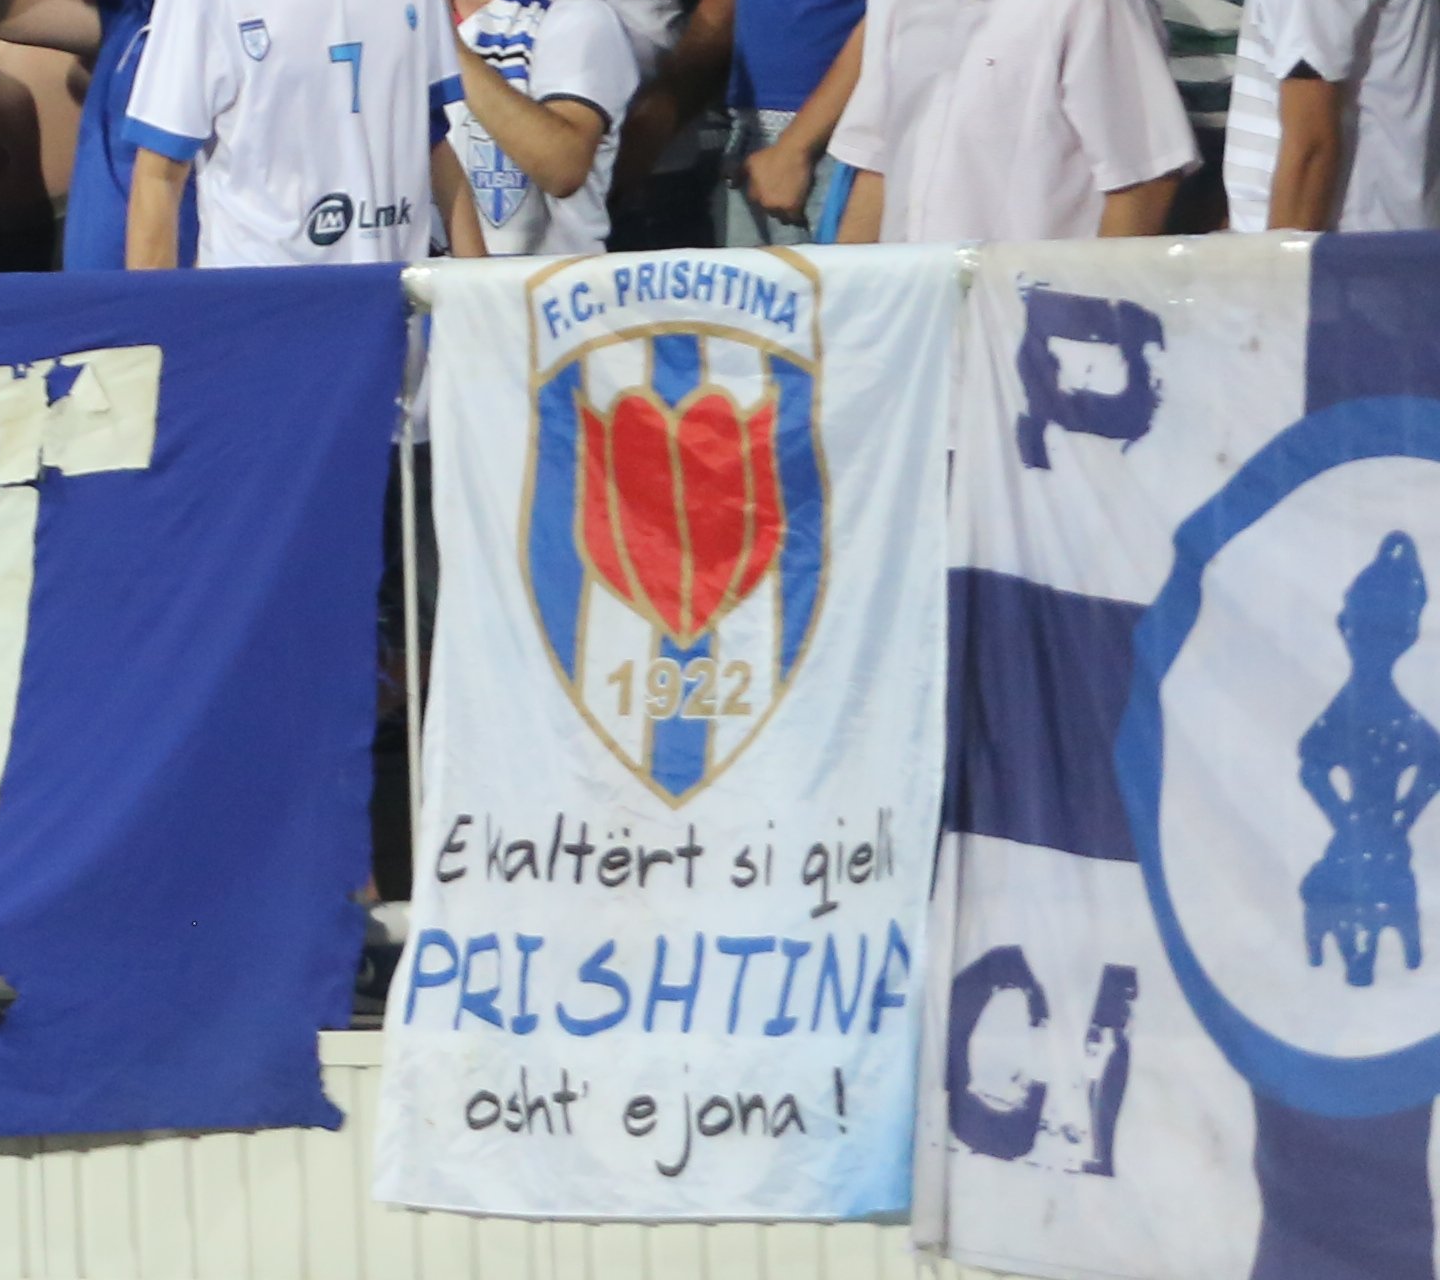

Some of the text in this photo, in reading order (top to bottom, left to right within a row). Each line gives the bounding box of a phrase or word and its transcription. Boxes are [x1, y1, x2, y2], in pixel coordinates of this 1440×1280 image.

[328, 41, 363, 113] 7
[614, 255, 801, 334] PRISHTINA
[604, 656, 755, 722] 1922
[435, 813, 473, 884] E
[730, 817, 775, 888] si
[403, 917, 912, 1039] PRISHTINA
[622, 1093, 658, 1138] e
